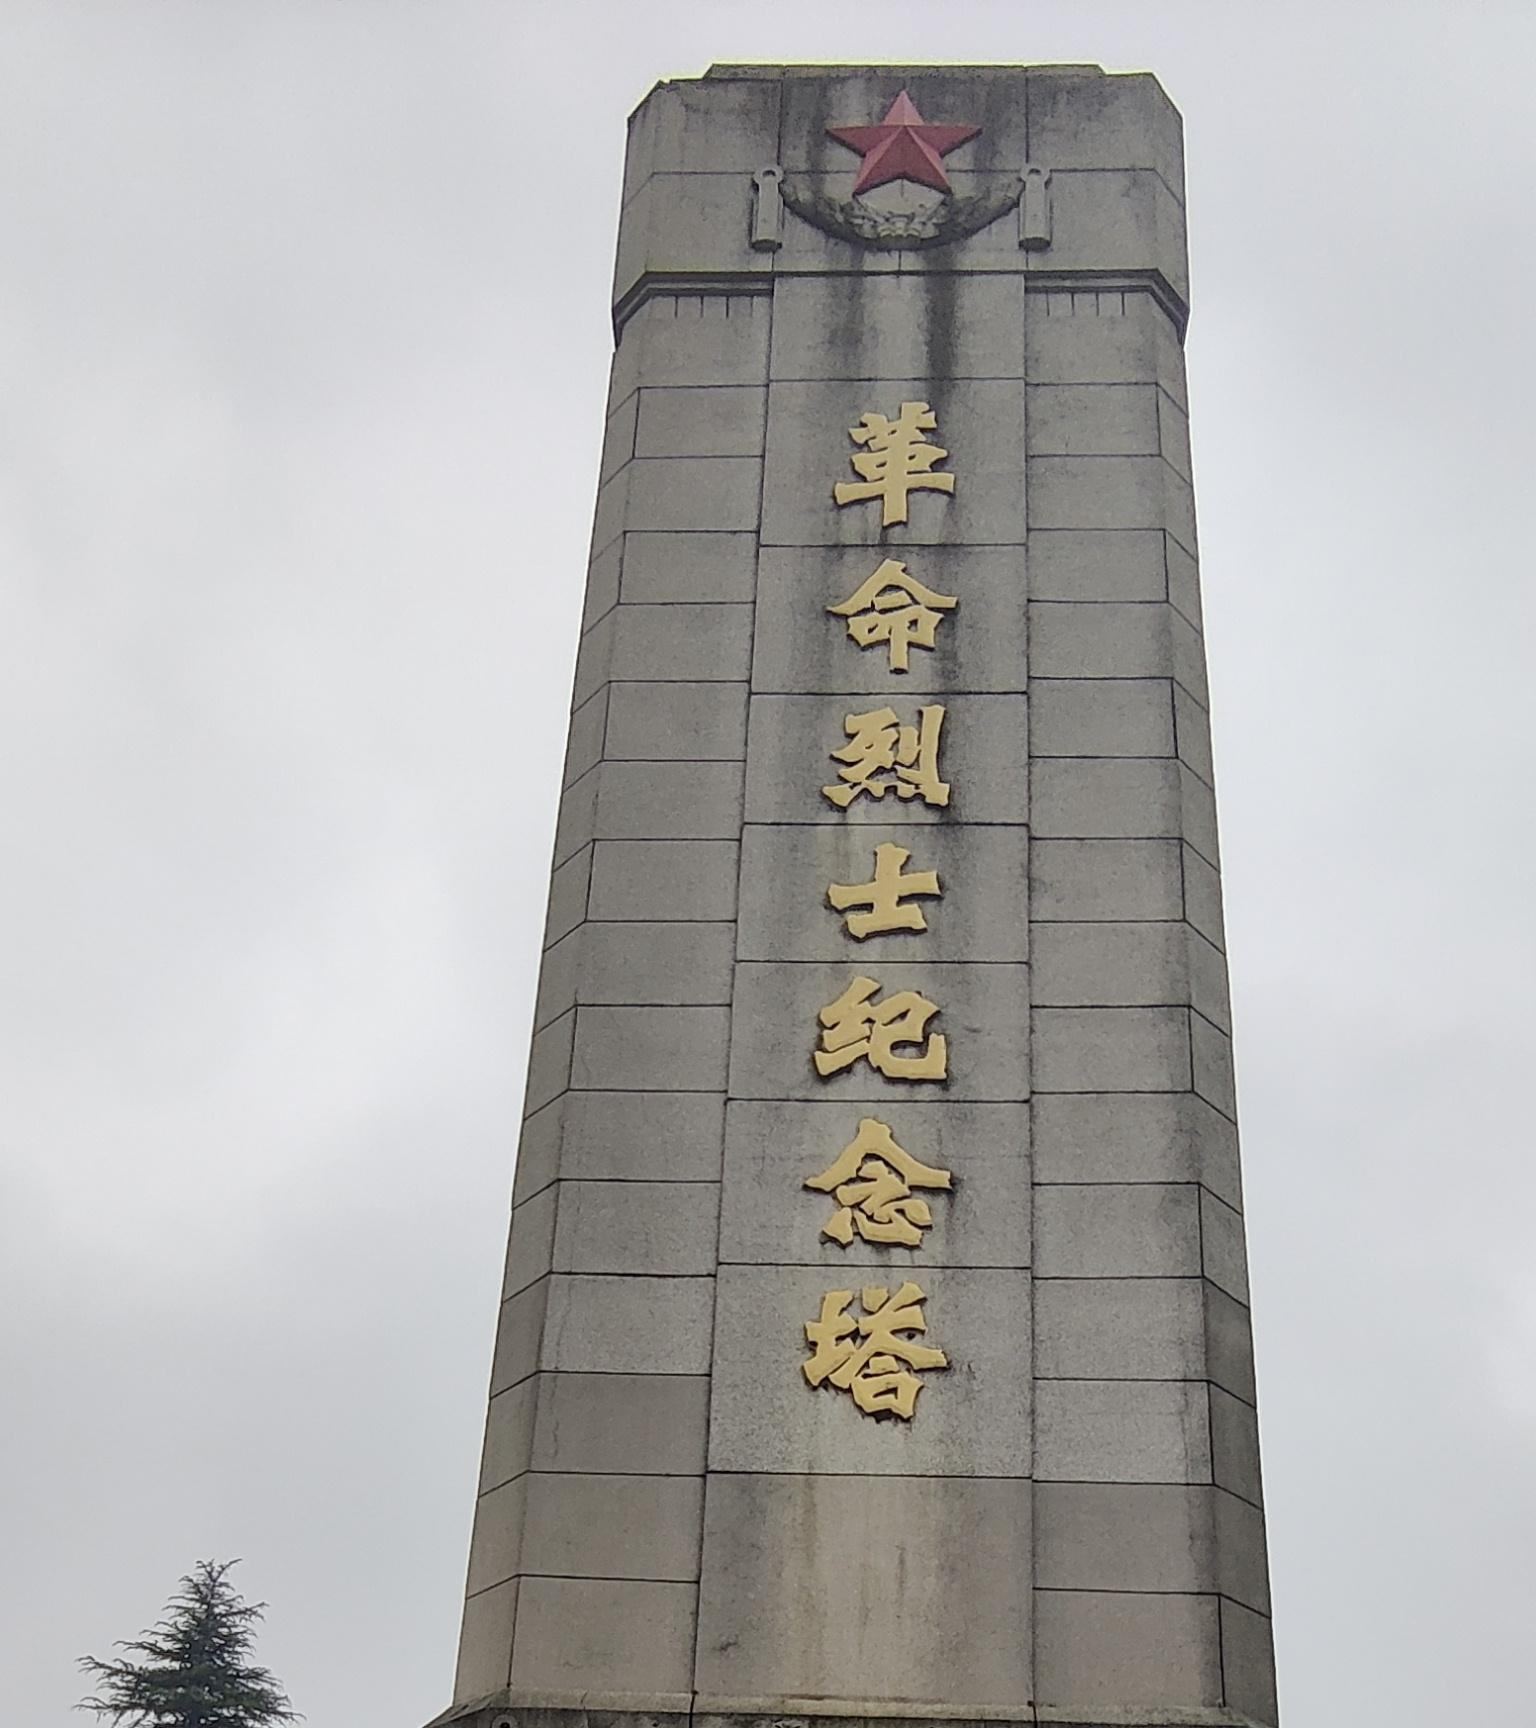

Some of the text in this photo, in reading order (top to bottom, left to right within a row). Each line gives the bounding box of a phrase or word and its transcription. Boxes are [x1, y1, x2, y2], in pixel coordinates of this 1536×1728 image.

[802, 401, 957, 1422] 革命烈士纪念塔
